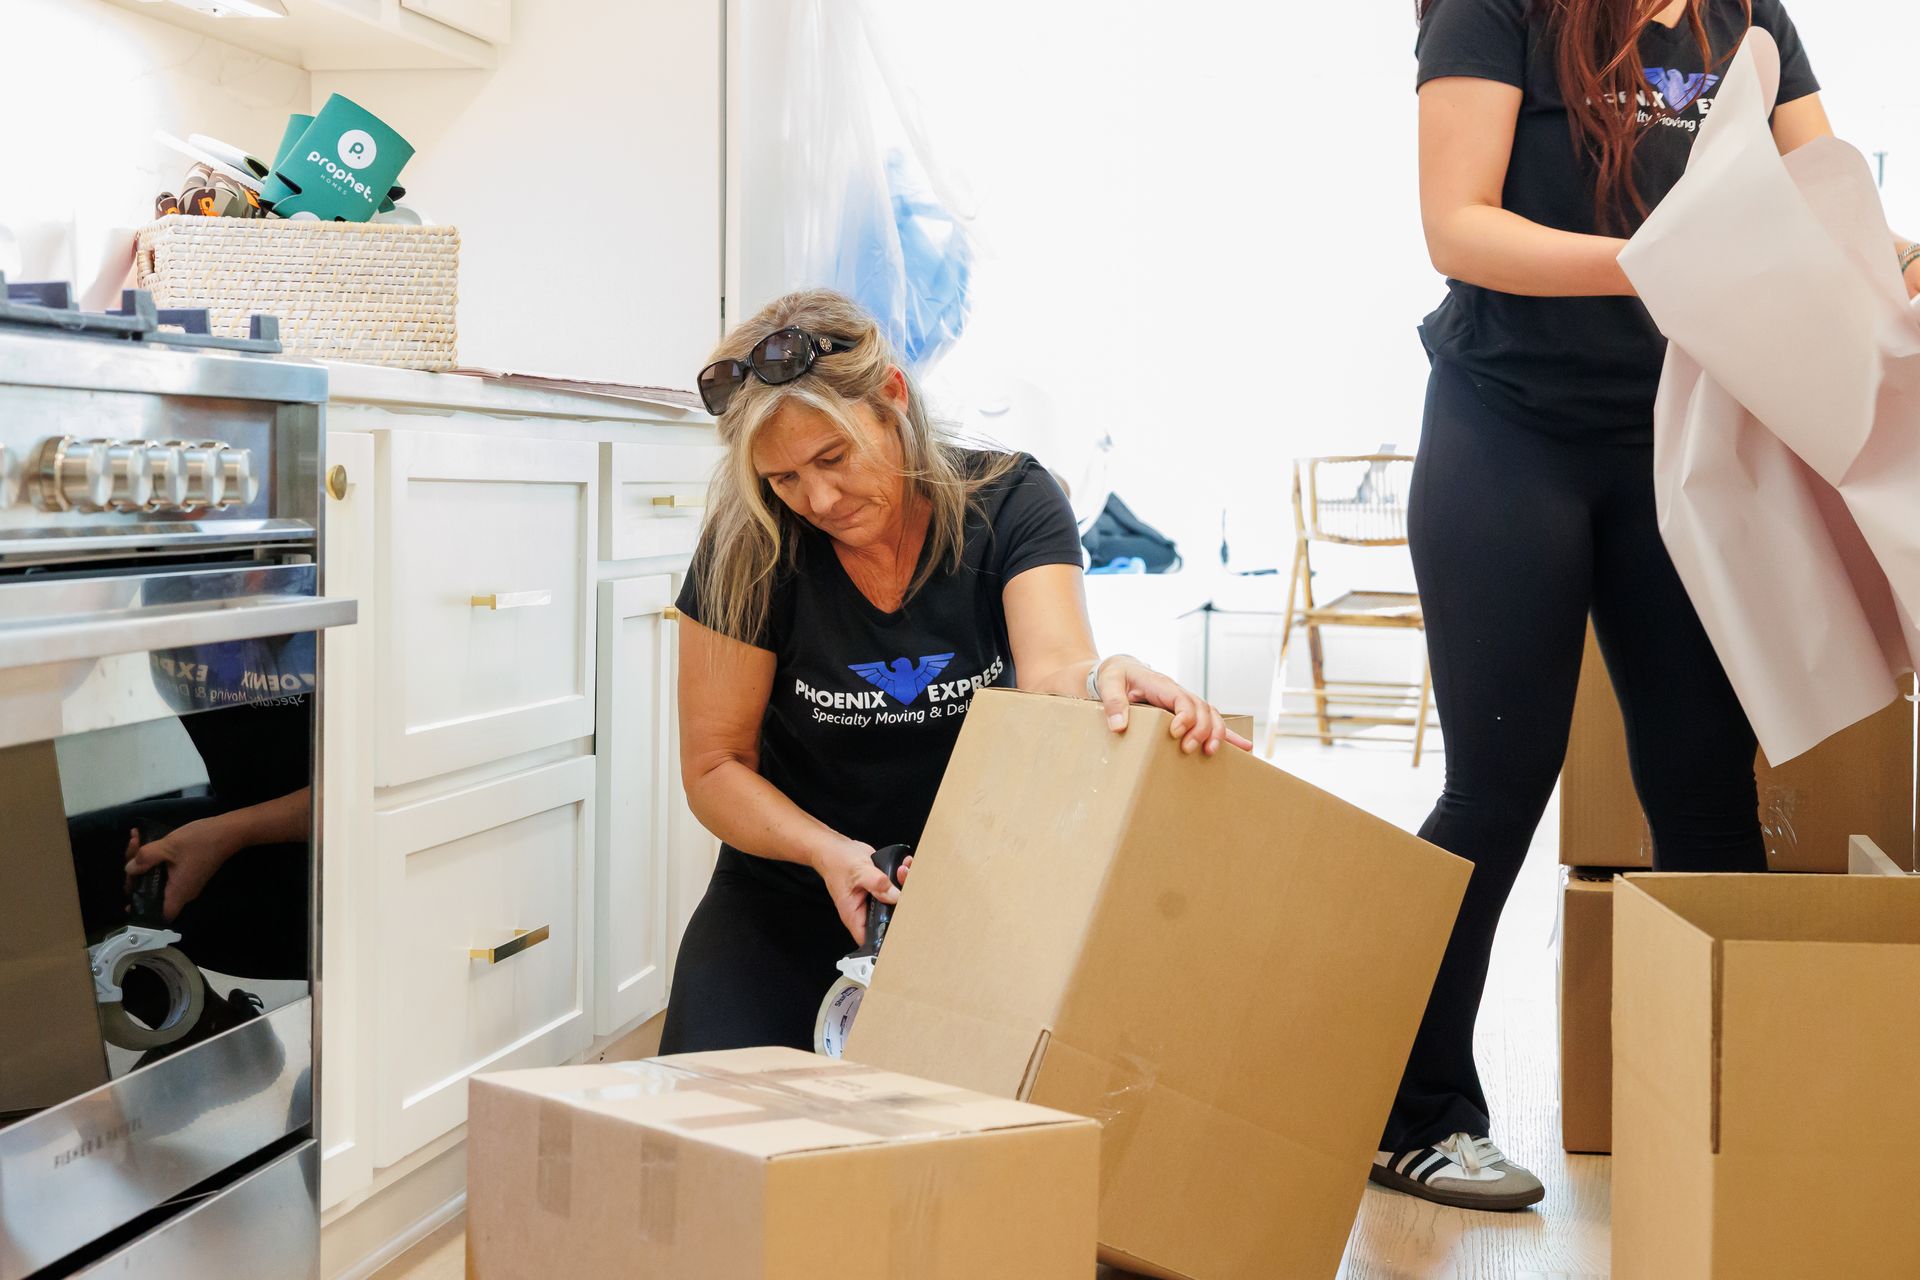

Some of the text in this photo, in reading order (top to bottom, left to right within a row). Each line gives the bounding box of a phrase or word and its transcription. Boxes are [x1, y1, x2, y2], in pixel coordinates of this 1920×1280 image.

[1656, 112, 1696, 132] oving
[306, 150, 373, 203] prophet.
[320, 174, 348, 195] HOMES
[794, 654, 1004, 710] PHOENIX EXPRESS
[811, 707, 872, 729] Specialty
[874, 708, 926, 725] Moving
[929, 705, 943, 719] &
